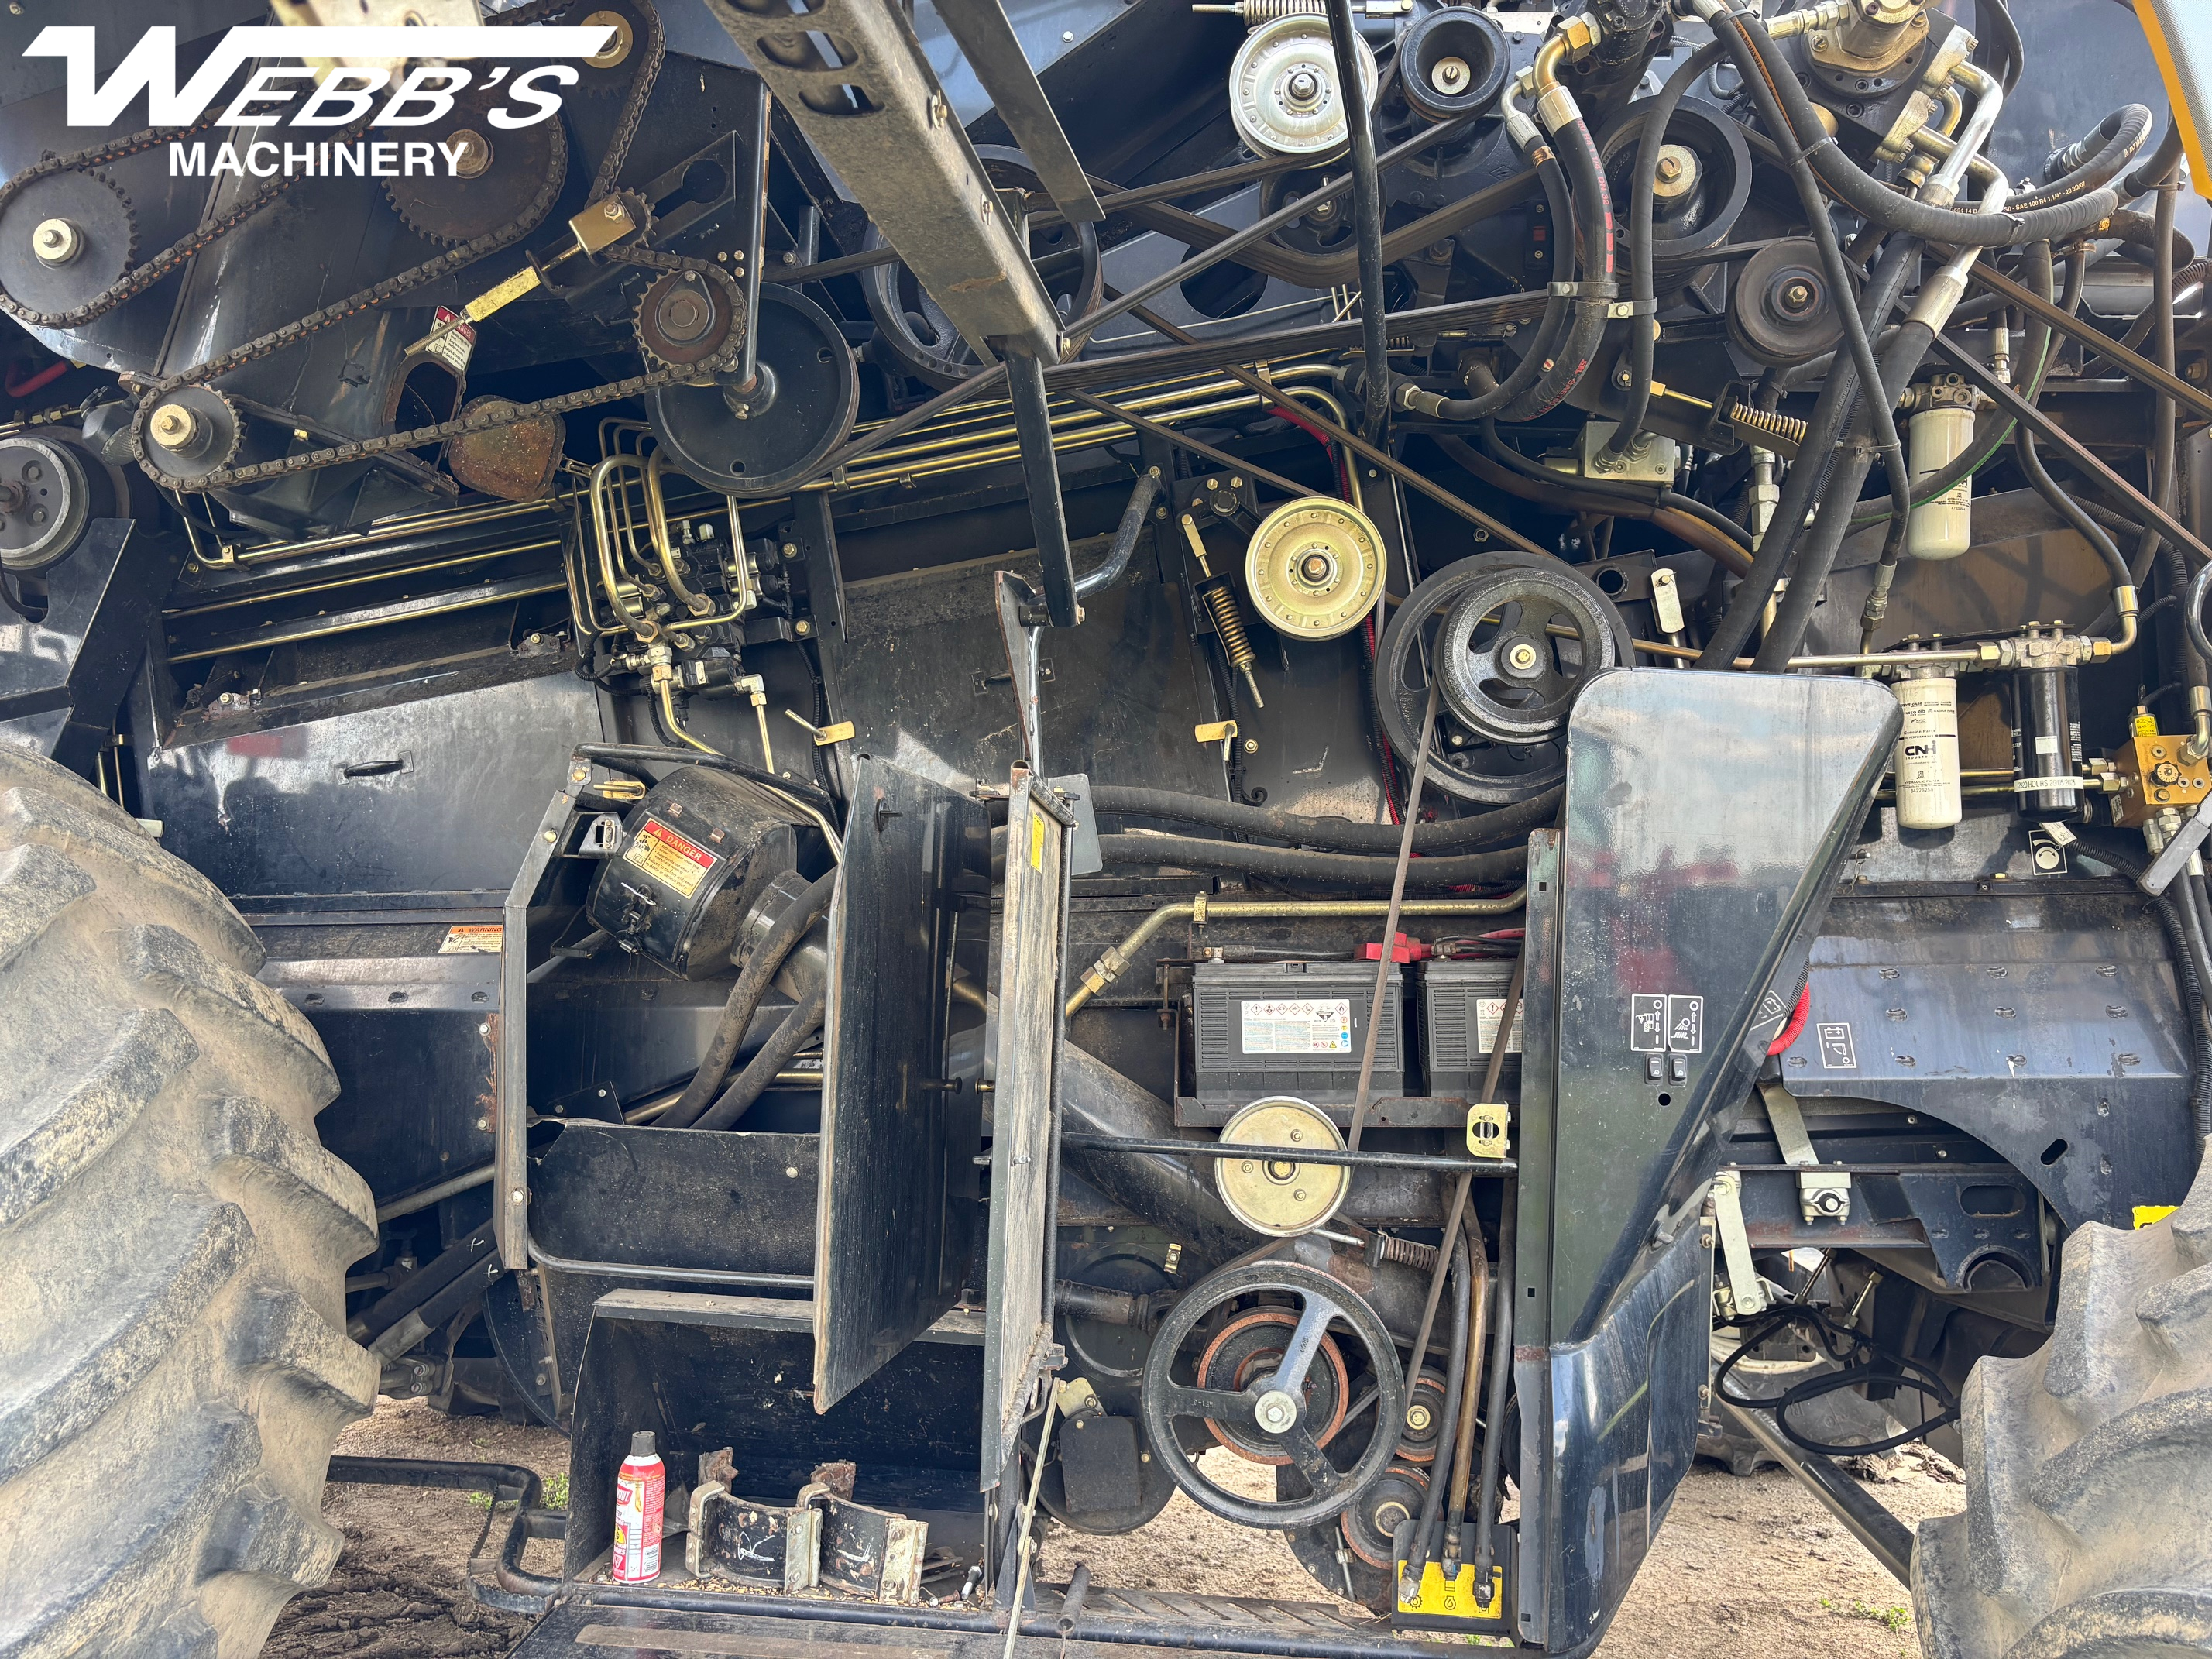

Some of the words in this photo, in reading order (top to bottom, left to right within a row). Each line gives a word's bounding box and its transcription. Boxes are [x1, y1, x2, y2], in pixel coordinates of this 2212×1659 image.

[1576, 118, 1585, 131] 00
[1583, 133, 1592, 146] R4
[1597, 177, 1607, 191] DN
[1602, 194, 1609, 205] 32
[458, 325, 472, 339] ANGER
[665, 835, 702, 860] DANGER
